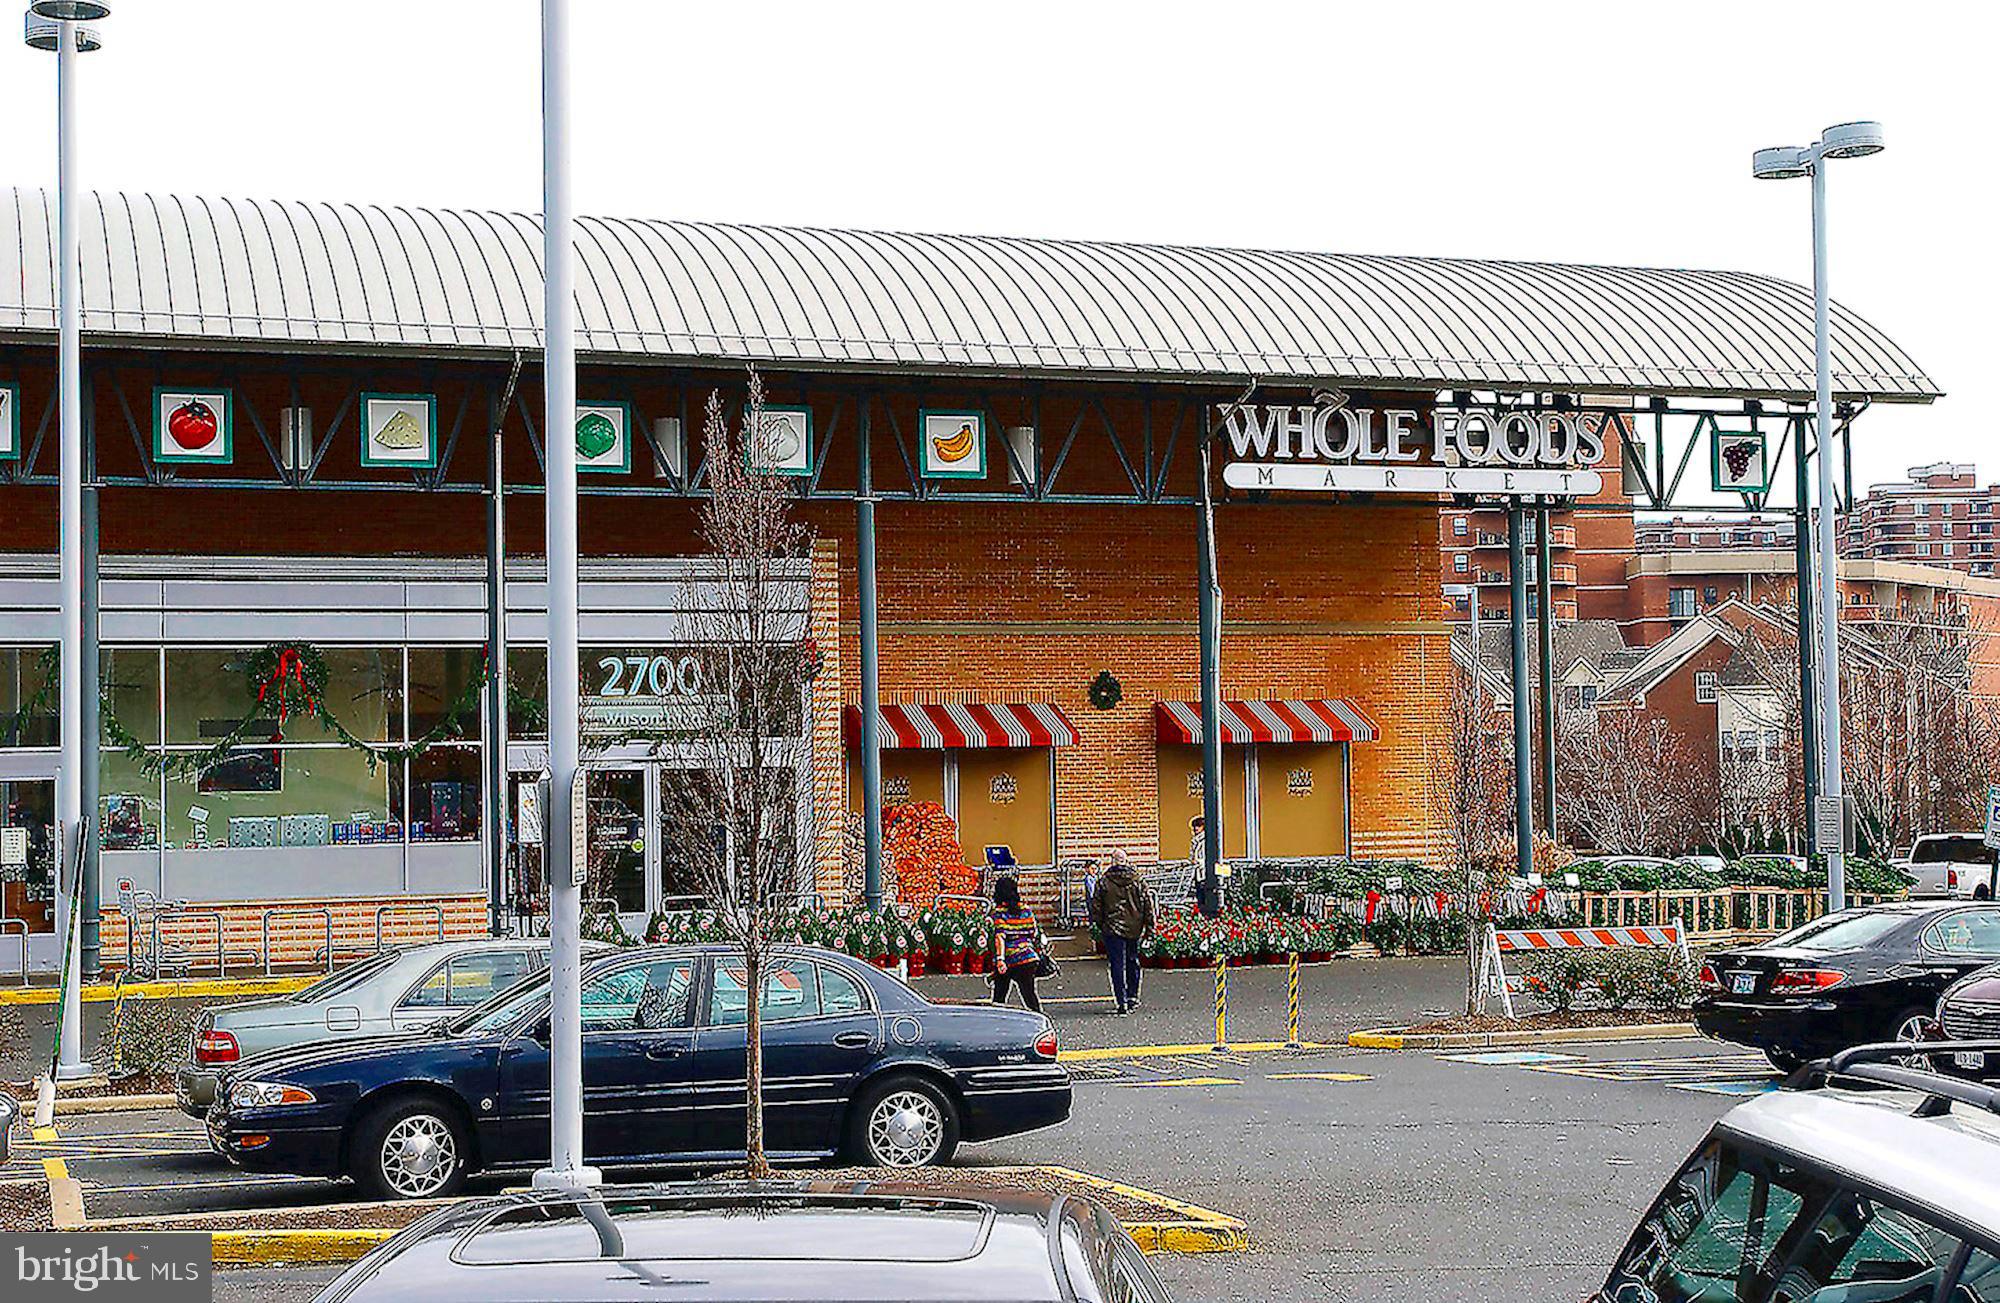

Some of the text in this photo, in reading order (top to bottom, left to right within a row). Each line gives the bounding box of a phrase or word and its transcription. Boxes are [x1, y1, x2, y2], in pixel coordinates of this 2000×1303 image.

[1216, 392, 1605, 465] WHOLE FOODS
[1257, 467, 1574, 491] MARKET
[598, 655, 702, 696] 2700
